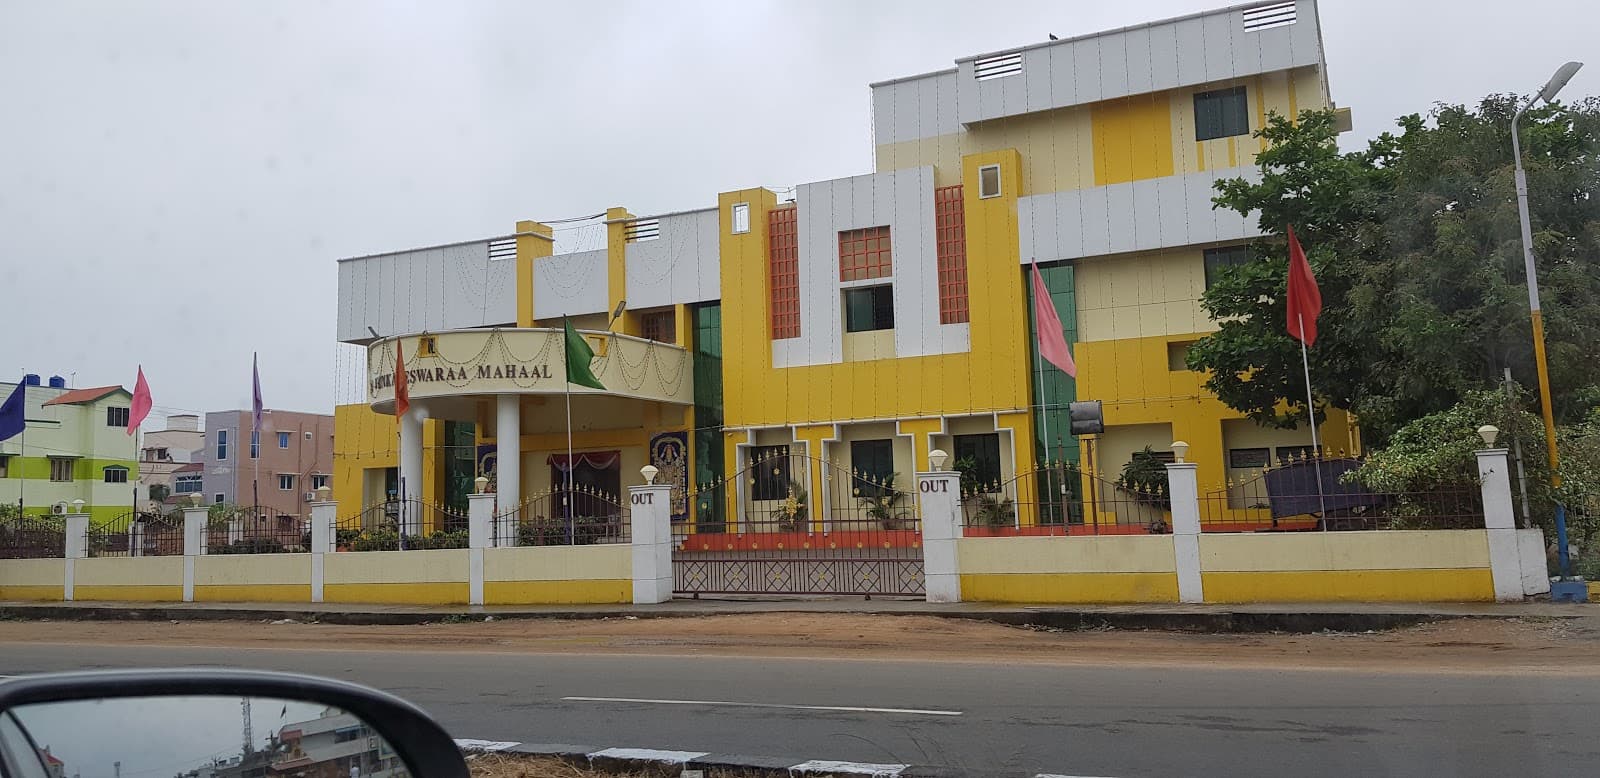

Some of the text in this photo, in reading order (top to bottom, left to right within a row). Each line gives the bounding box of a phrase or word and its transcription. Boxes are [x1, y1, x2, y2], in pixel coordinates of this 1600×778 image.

[477, 364, 553, 379] MAHAAL
[920, 479, 949, 493] OUT
[631, 492, 654, 505] OUT
